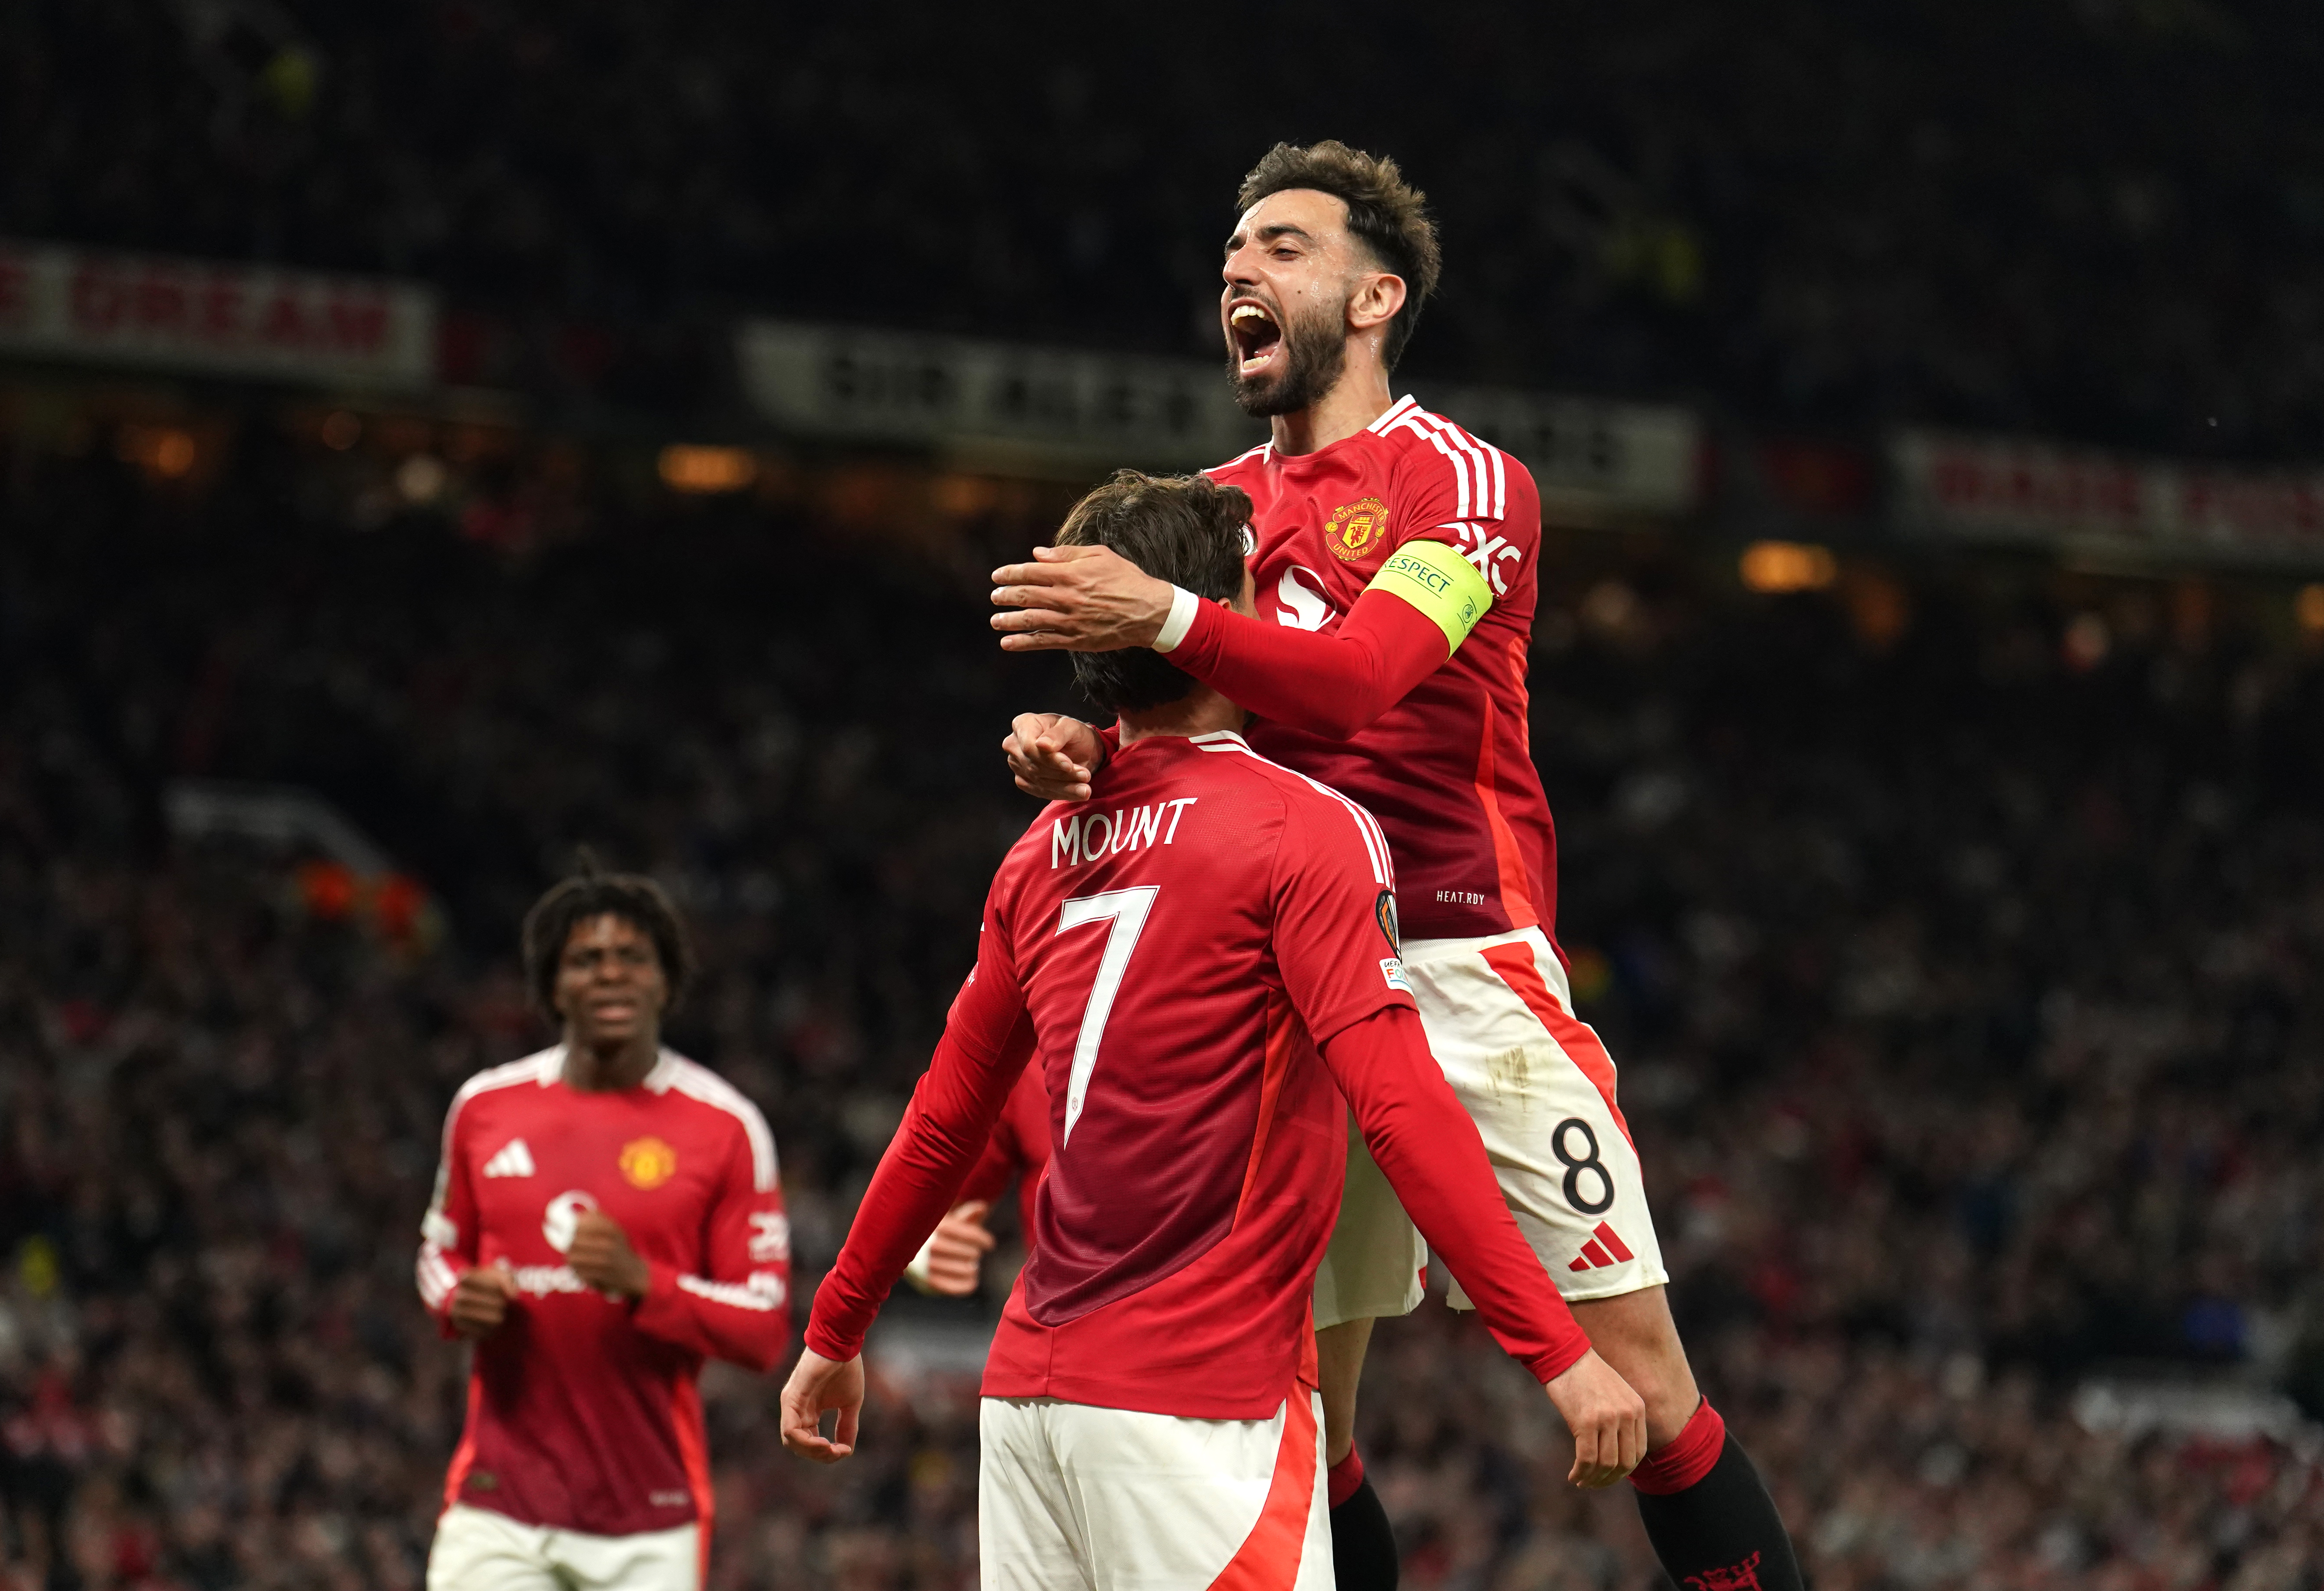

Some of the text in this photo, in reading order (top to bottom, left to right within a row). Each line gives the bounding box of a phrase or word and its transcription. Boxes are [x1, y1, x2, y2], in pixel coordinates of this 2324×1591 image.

[1338, 503, 1384, 522] MANCHESTER
[1333, 543, 1368, 557] UNITED
[1051, 797, 1198, 870] MOUNT
[1436, 890, 1485, 906] HEAT.RDY
[1054, 884, 1161, 1151] 7
[1551, 1117, 1615, 1216] 8
